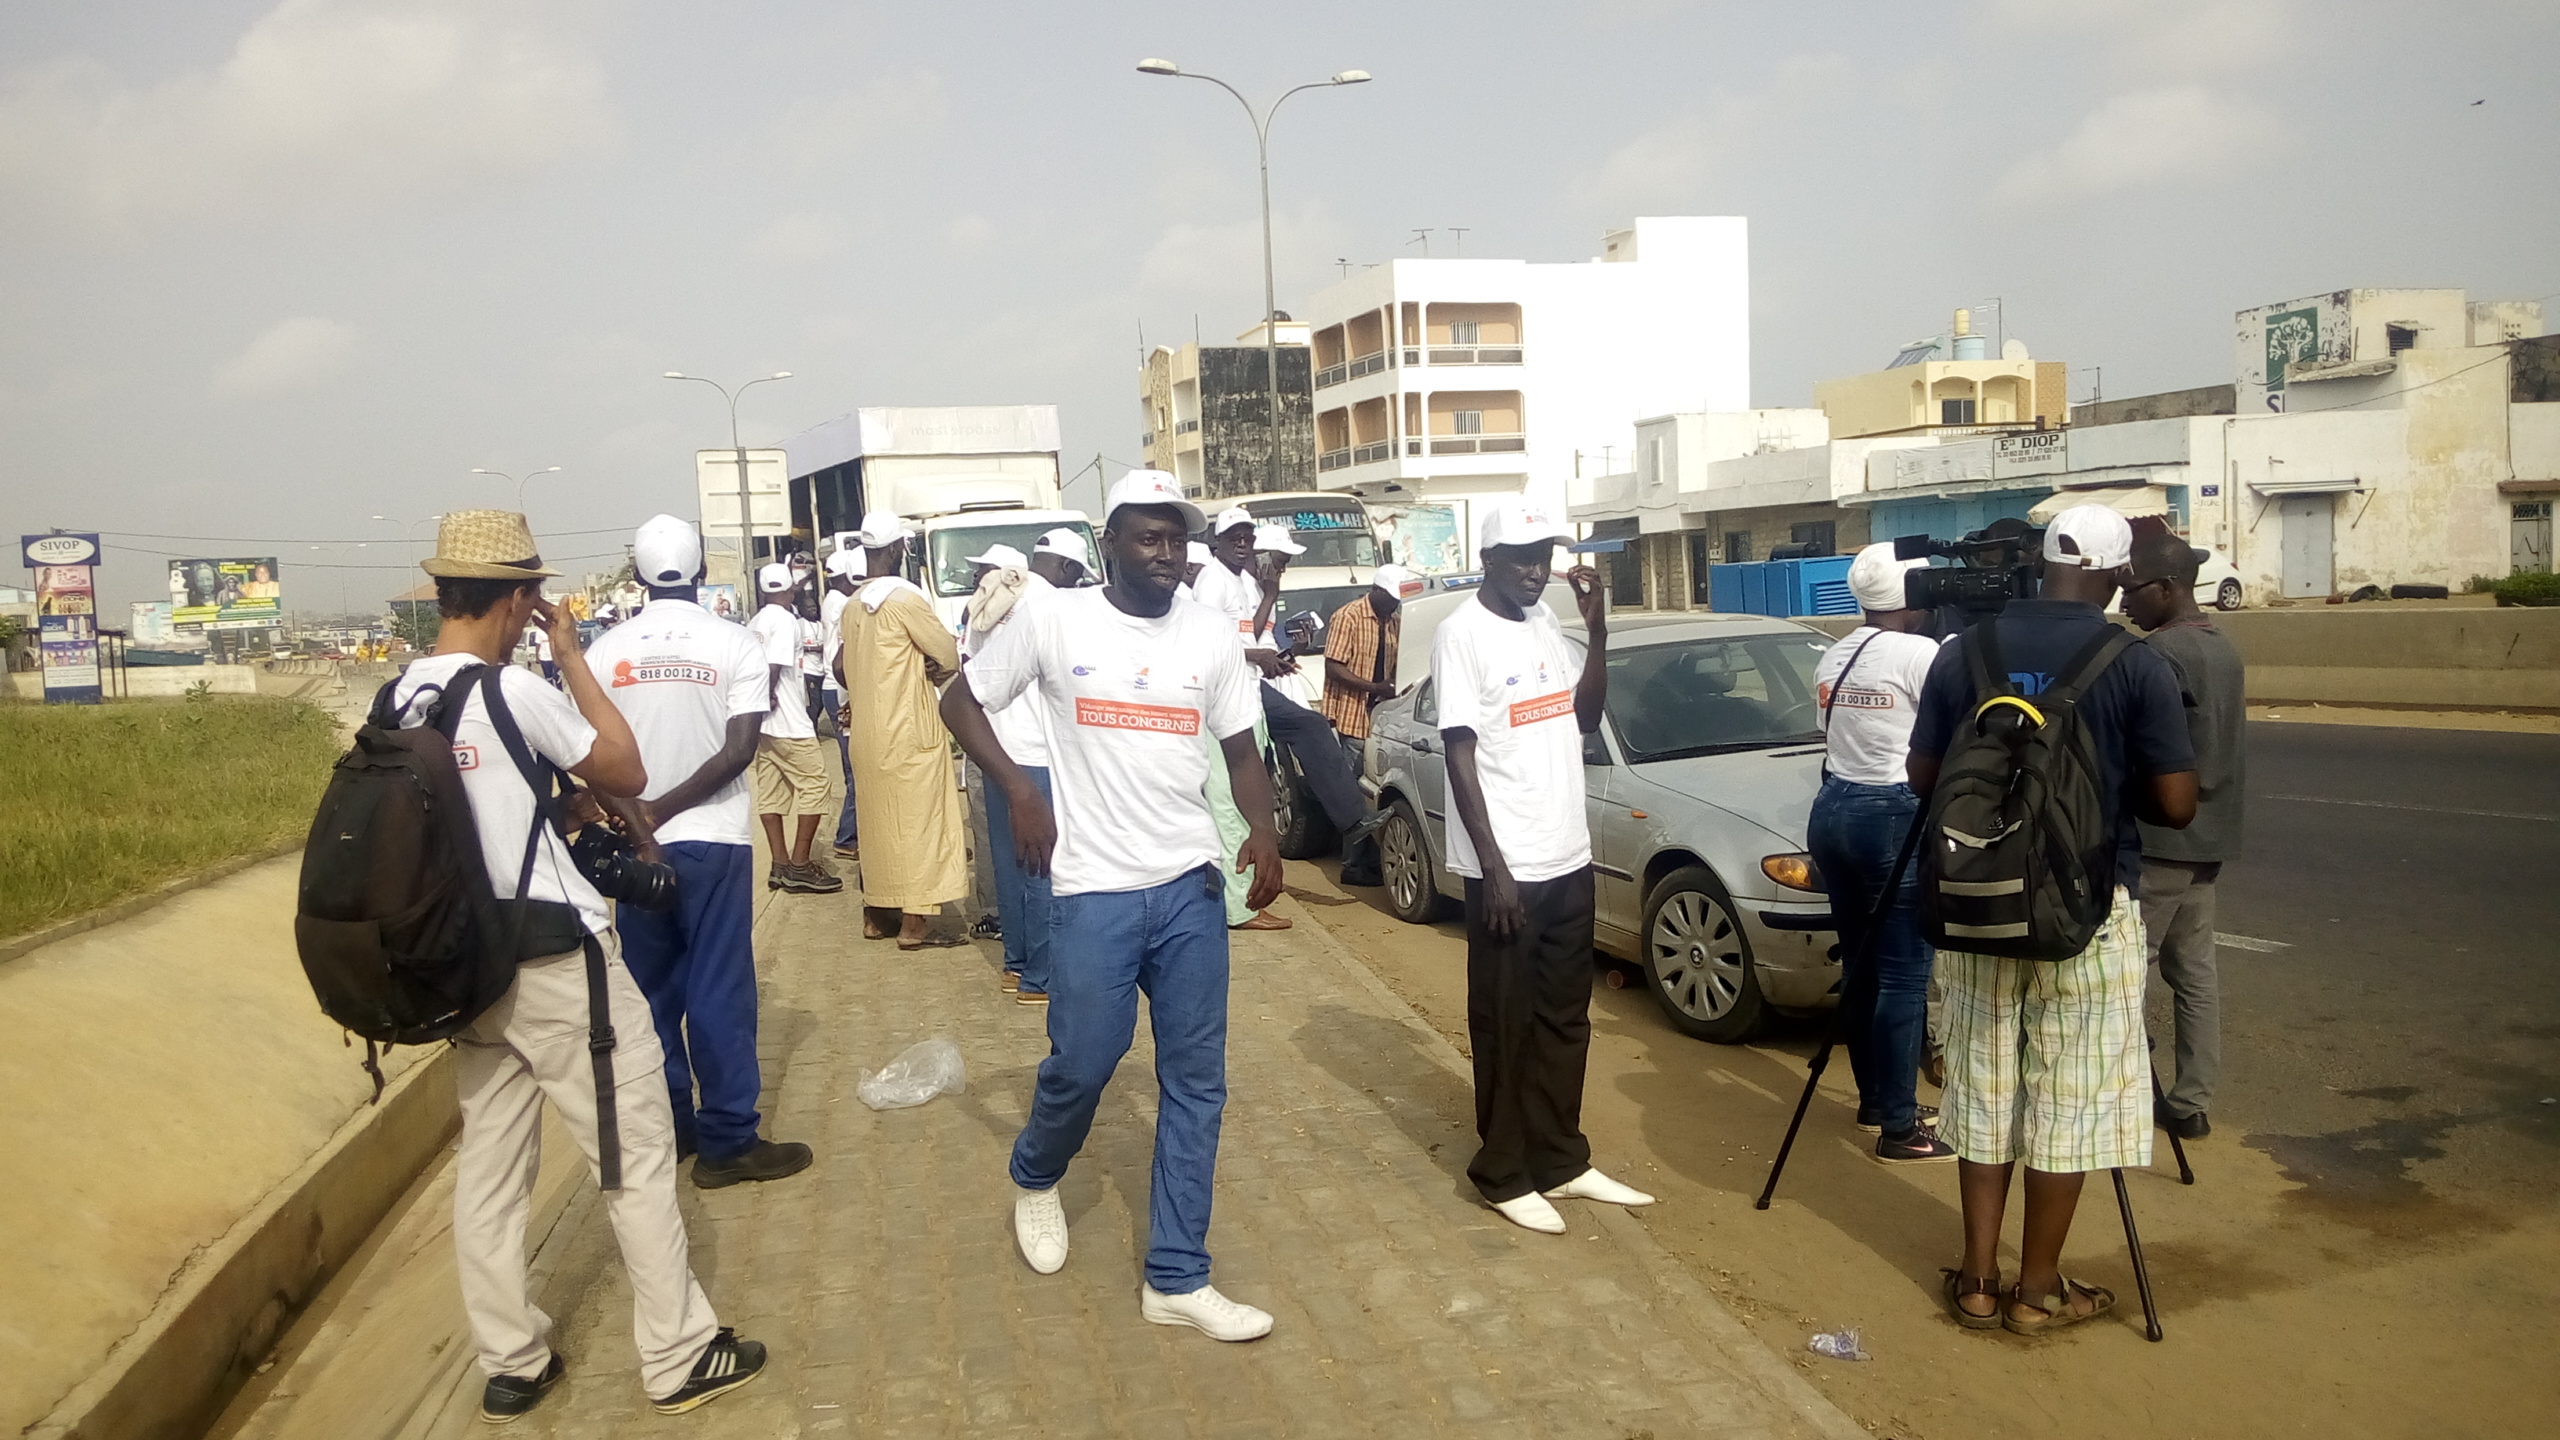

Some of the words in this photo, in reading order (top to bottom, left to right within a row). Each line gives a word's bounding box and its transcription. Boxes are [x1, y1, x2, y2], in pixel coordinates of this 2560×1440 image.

[2021, 434, 2060, 449] DIOP
[1317, 512, 1363, 529] ALLAH
[40, 540, 80, 551] SIVOP
[640, 668, 661, 679] 818
[664, 668, 680, 678] 00
[681, 668, 693, 678] 12
[696, 670, 710, 681] 12
[1847, 695, 1859, 704] 00
[1860, 696, 1871, 706] 12
[1874, 697, 1888, 706] 12
[1081, 710, 1117, 724] TOUS
[1118, 714, 1196, 732] CONCERNES
[1514, 708, 1541, 723] TOUS
